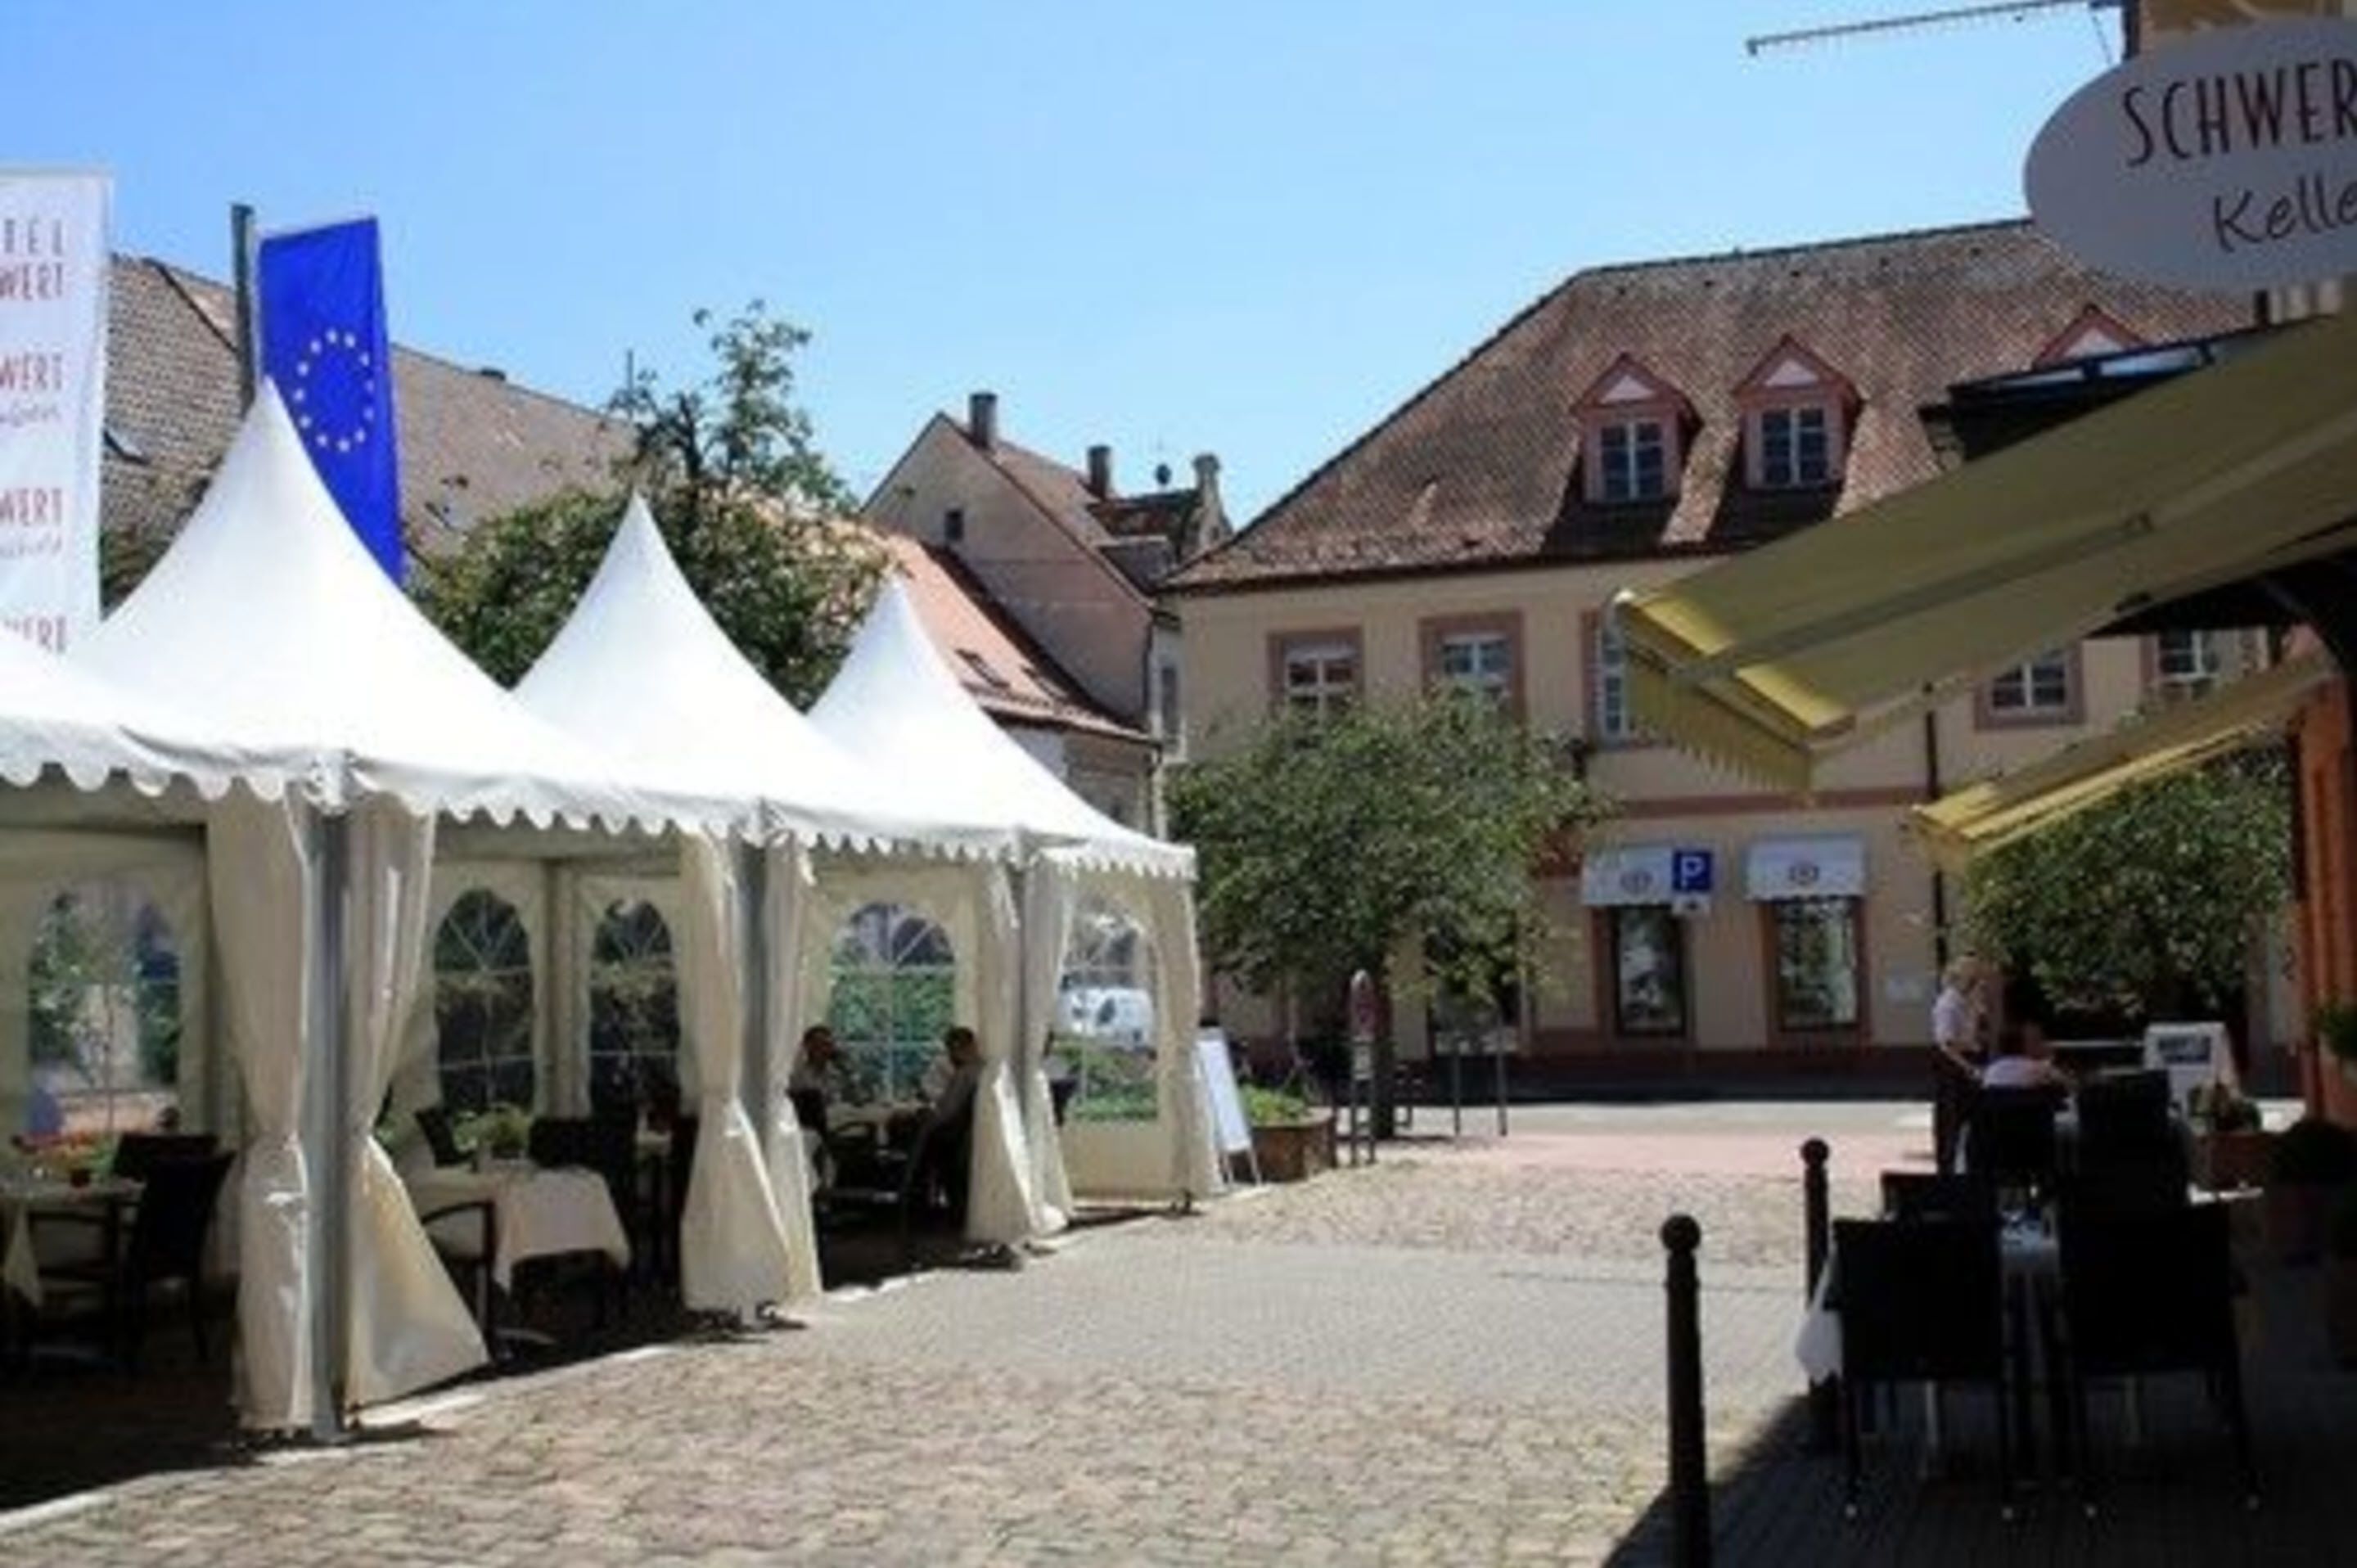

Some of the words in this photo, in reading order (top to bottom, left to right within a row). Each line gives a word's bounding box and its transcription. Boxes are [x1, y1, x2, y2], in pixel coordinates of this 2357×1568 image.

[2123, 57, 2357, 168] SCHWER
[2213, 171, 2357, 254] Kelle
[1679, 856, 1704, 888] P
